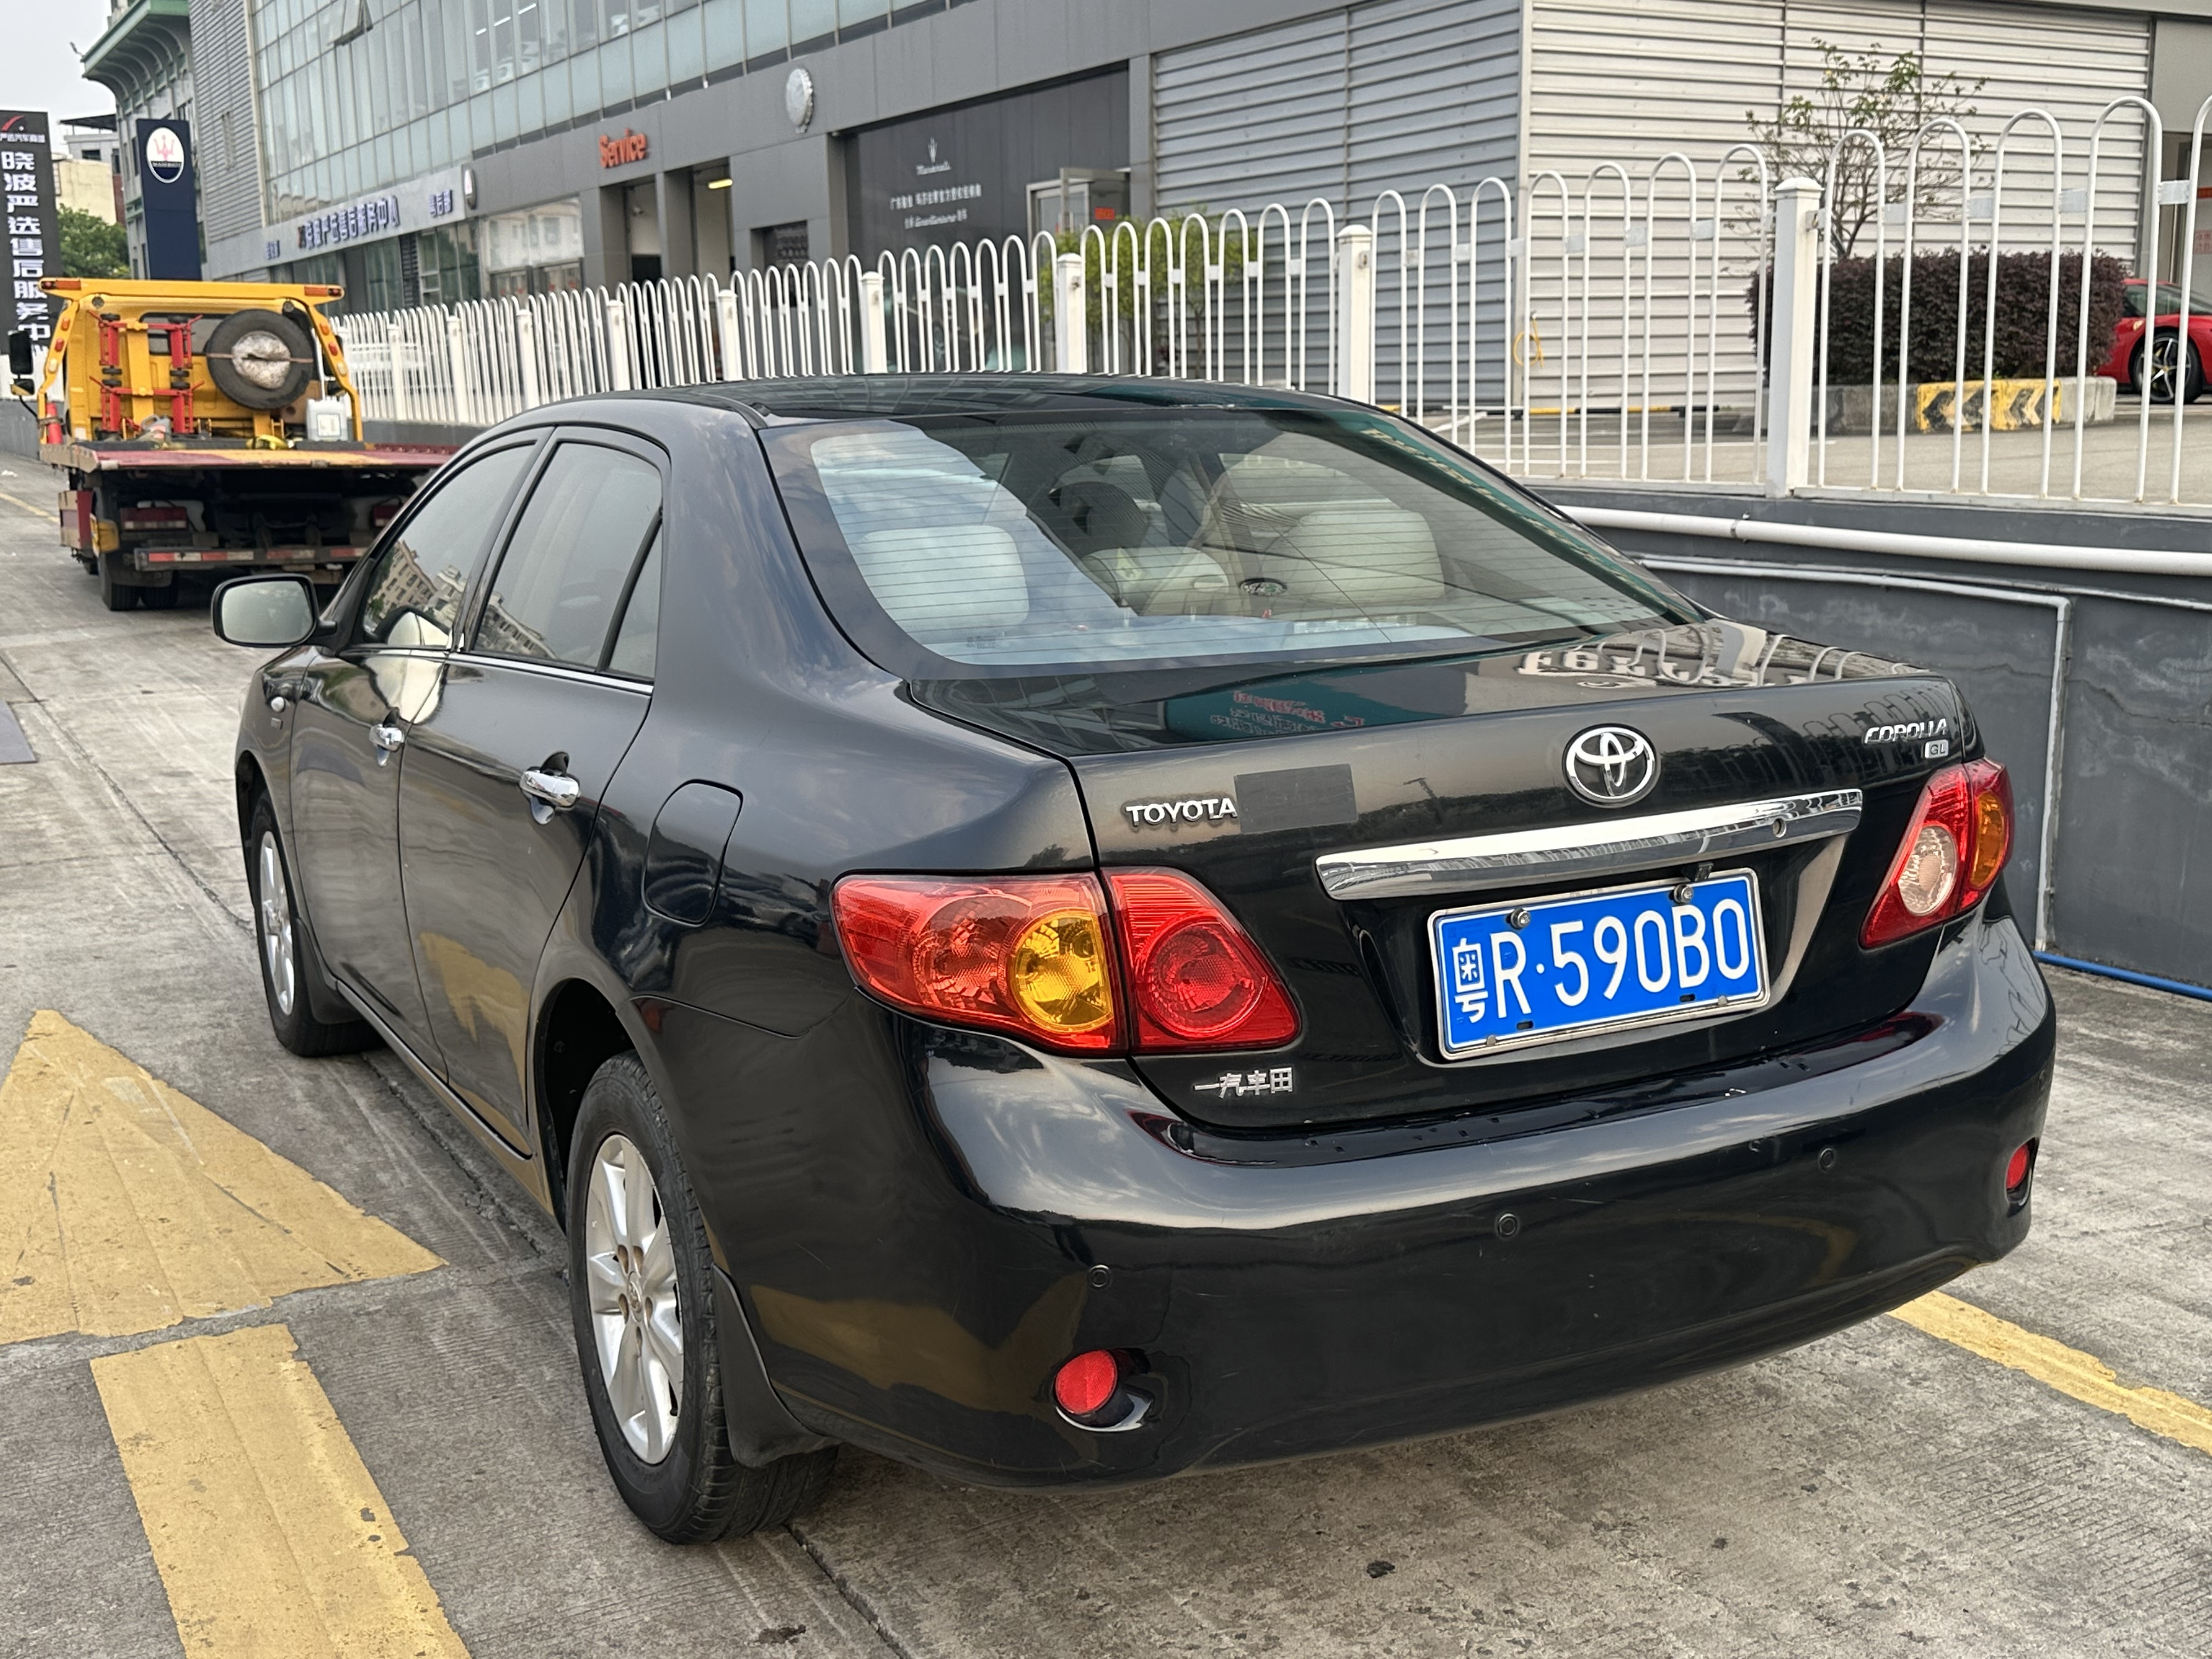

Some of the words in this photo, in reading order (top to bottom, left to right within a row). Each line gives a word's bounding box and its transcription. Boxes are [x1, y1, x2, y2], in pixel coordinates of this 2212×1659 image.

[600, 128, 646, 168] Service
[1864, 718, 1947, 744] COROLLA
[1930, 744, 1946, 755] GL
[1126, 798, 1238, 827] TOYOTA
[1194, 1067, 1293, 1099] 一汽丰田
